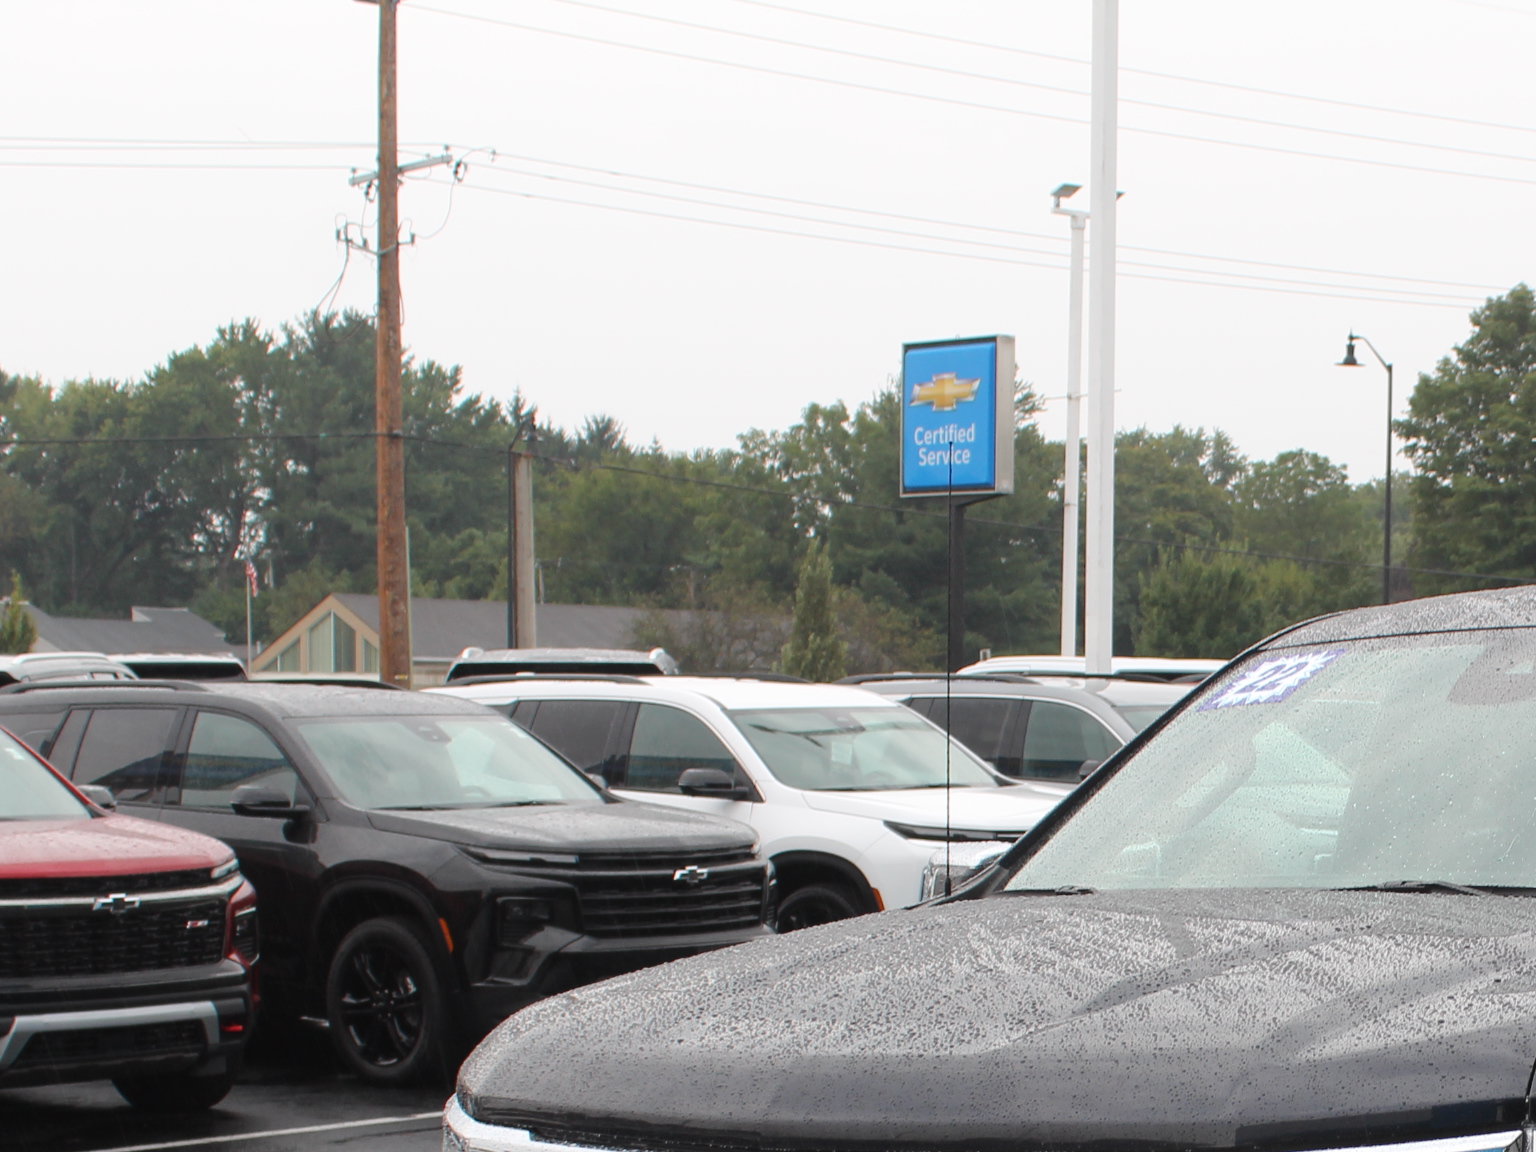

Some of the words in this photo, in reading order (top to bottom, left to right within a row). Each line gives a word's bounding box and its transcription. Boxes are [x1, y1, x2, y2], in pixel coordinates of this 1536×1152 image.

[913, 423, 976, 445] Certified
[918, 445, 971, 467] Service
[1234, 663, 1309, 694] 22
